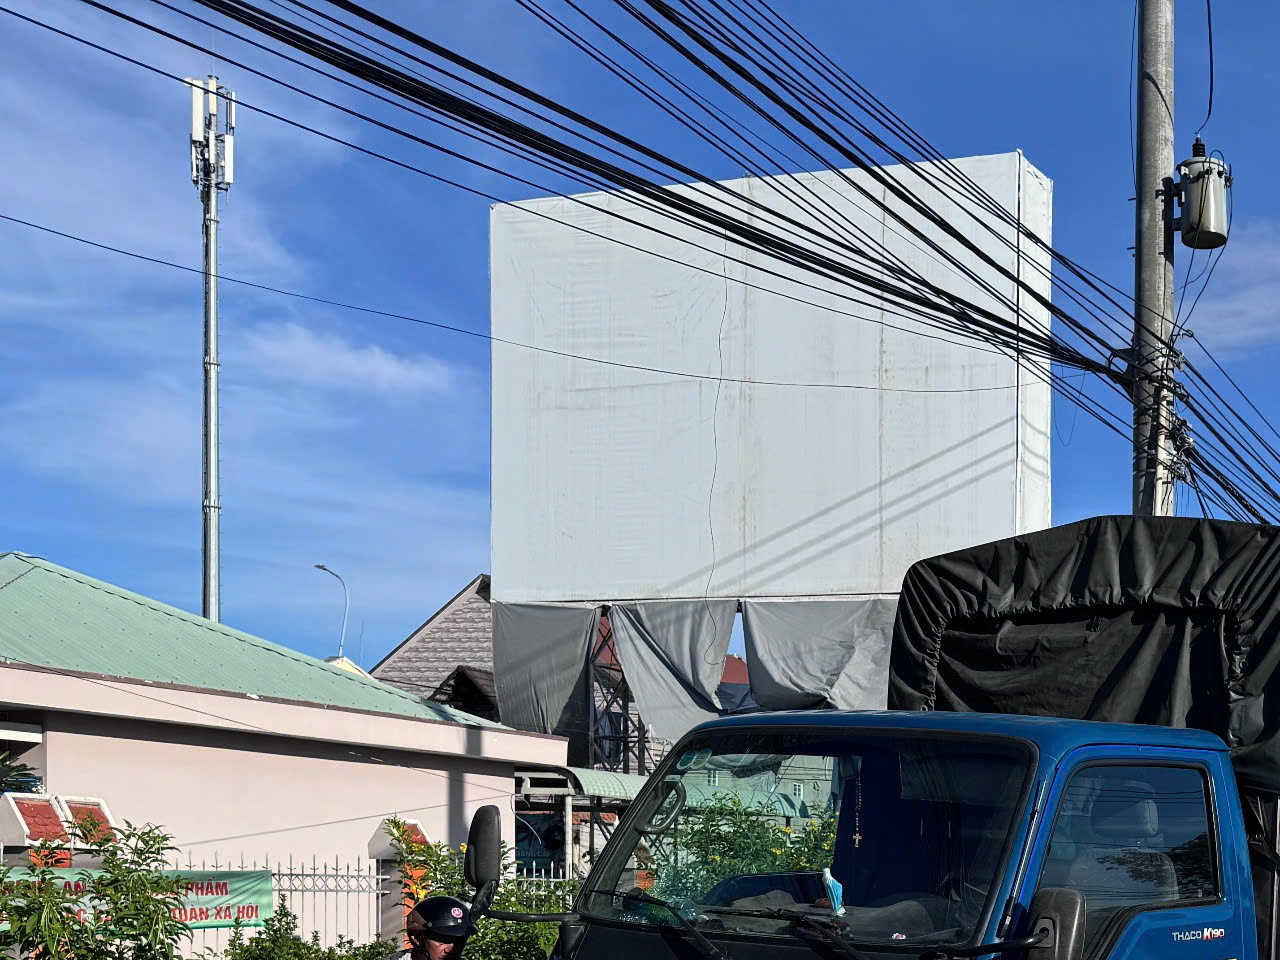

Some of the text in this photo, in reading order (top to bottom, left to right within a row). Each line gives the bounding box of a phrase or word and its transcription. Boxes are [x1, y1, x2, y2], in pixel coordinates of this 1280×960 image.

[184, 876, 229, 896] PHẨM
[214, 903, 232, 920] XÃ
[1172, 928, 1224, 941] THACO K190
